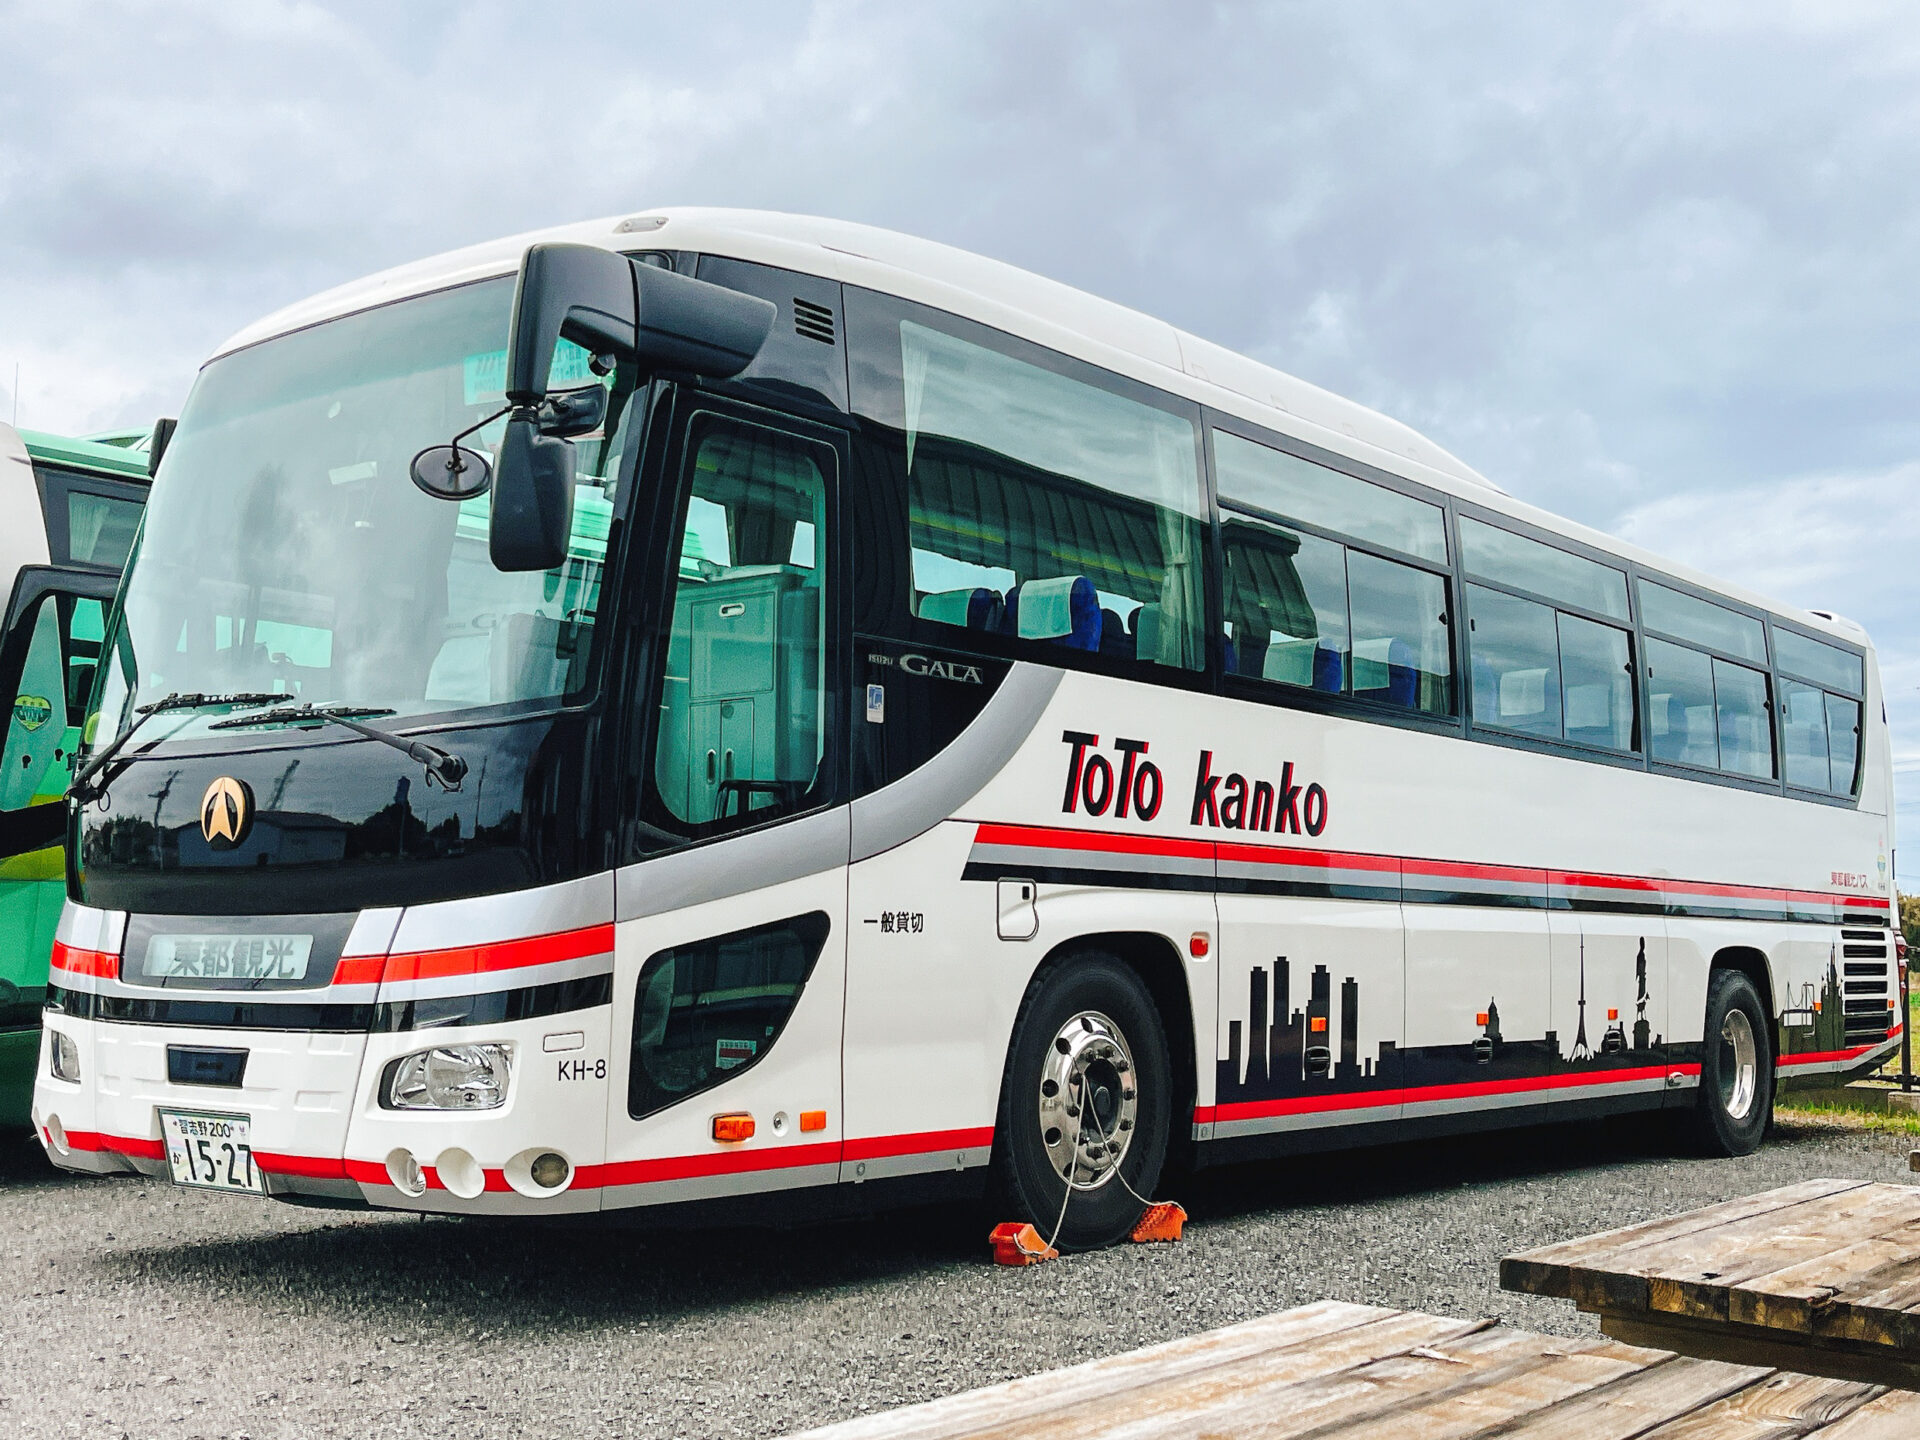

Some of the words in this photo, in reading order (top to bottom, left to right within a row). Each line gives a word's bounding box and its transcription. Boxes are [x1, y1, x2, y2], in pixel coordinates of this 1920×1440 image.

[900, 654, 982, 684] GALA
[1062, 730, 1164, 821] ToTo
[1190, 750, 1329, 837] kanko
[863, 910, 924, 933] 一般貸切
[171, 938, 295, 978] 東都観光
[558, 1059, 606, 1081] KH-8
[173, 1152, 181, 1164] か
[184, 1138, 252, 1187] 15-27
